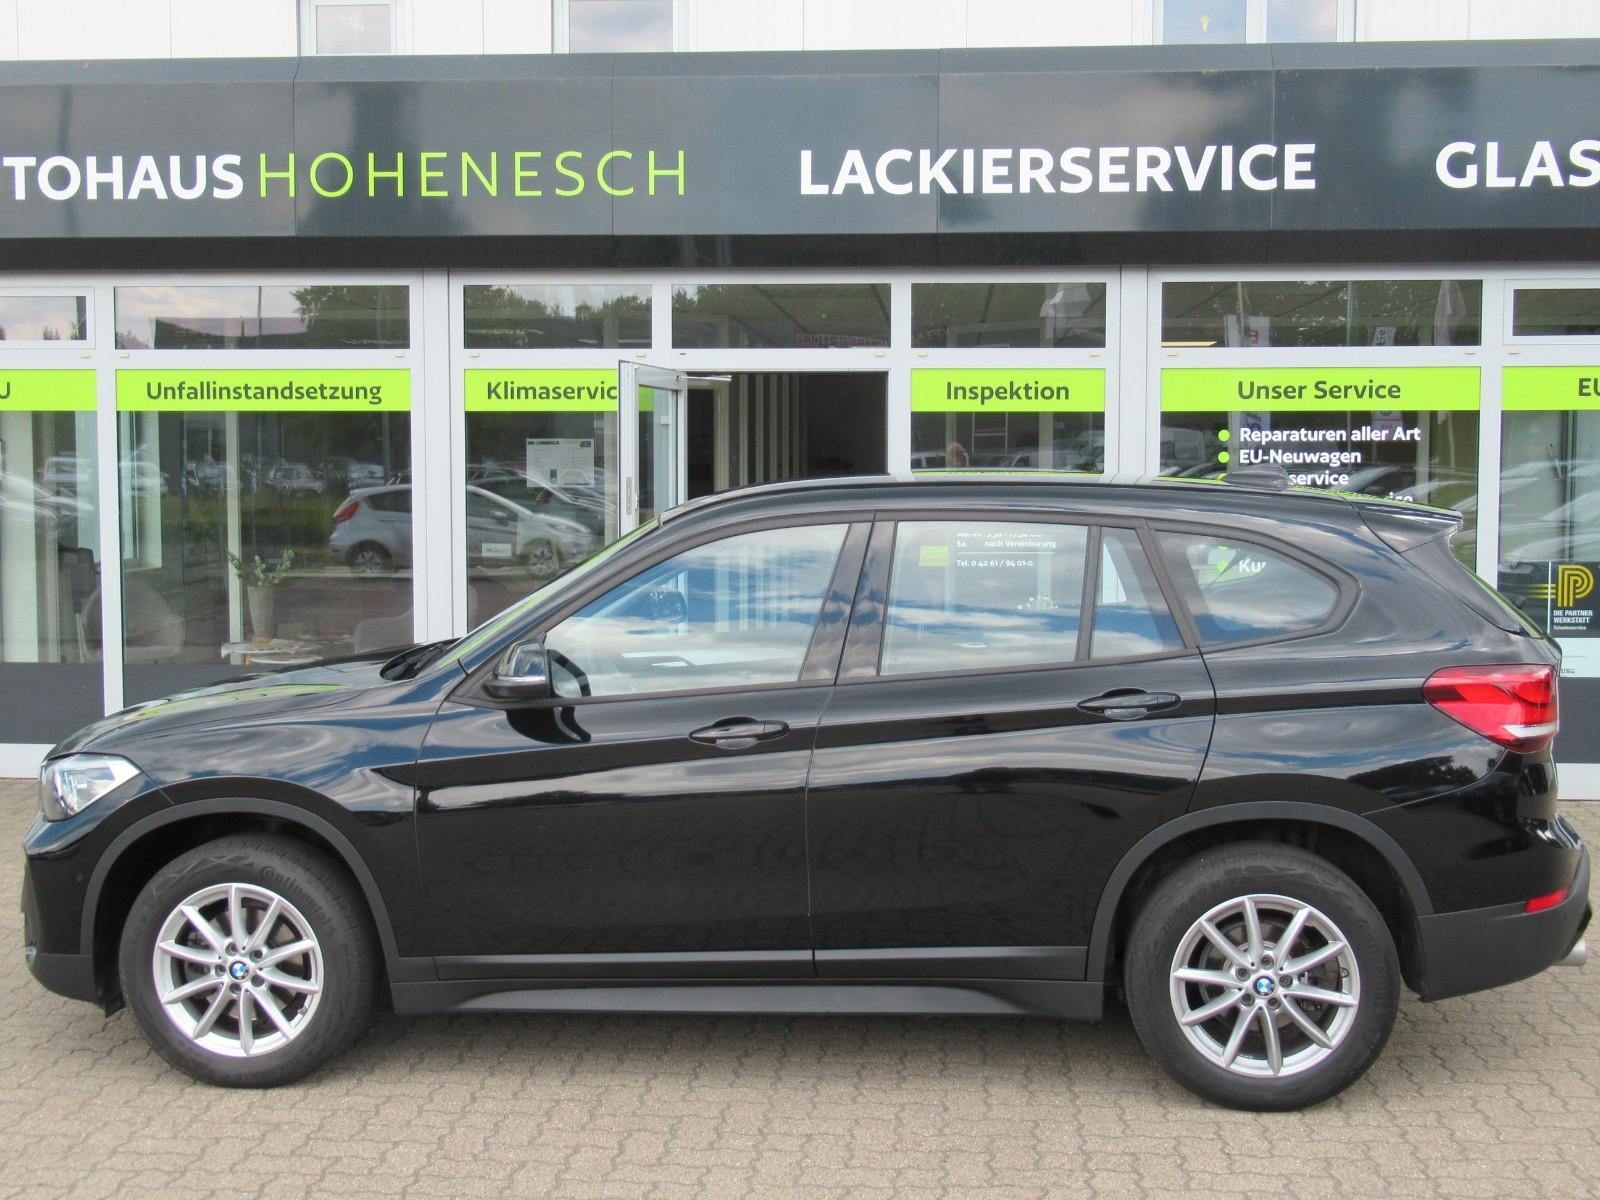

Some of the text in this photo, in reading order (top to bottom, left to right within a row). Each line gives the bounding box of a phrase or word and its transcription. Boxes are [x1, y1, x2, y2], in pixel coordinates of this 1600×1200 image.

[800, 143, 1316, 195] LACKIERSERVICE
[1435, 139, 1600, 189] GLAS
[3, 149, 686, 201] TOHAUS HOHENESCH
[146, 380, 382, 405] Unfallinstandsetzung
[487, 381, 618, 400] Klimaservic
[946, 380, 1070, 405] Inspektion
[1238, 379, 1401, 400] Unser Service
[1239, 426, 1421, 445] Reparaturen aller Art
[1239, 449, 1362, 467] EU-Neuwagen
[1288, 470, 1349, 486] service
[984, 540, 1003, 548] nach
